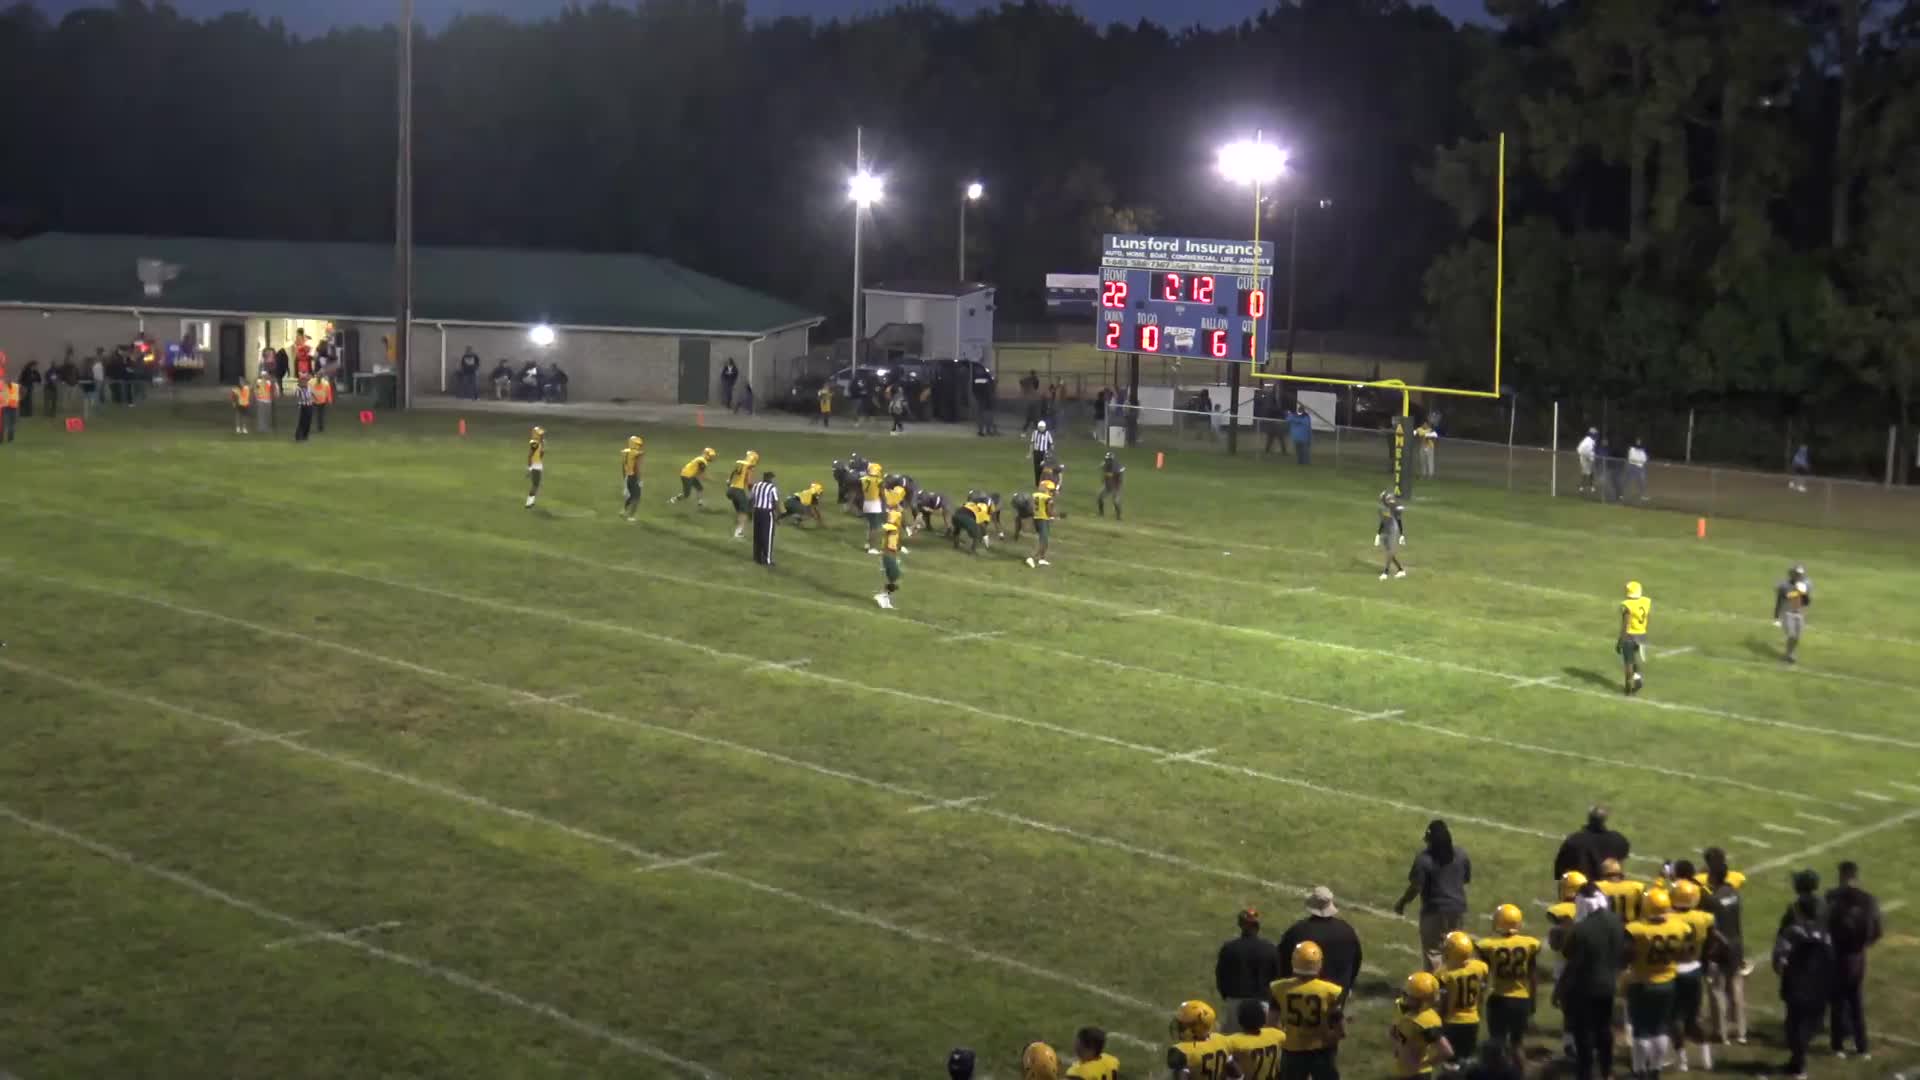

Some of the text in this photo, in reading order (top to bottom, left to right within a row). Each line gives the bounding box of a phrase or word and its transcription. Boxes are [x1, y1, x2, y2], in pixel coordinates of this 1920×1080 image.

[1112, 236, 1263, 256] Lunsford Insurance
[1104, 268, 1127, 279] HOME
[1103, 281, 1127, 308] 22
[1249, 290, 1264, 317] 0
[1105, 310, 1124, 322] DOWN
[1137, 312, 1157, 324] TO GO
[1106, 323, 1120, 347] 2
[1142, 325, 1158, 351] 10
[1164, 326, 1196, 336] PEPSI
[1212, 331, 1227, 357] 6
[1638, 606, 1646, 624] 3
[1286, 993, 1321, 1026] 53
